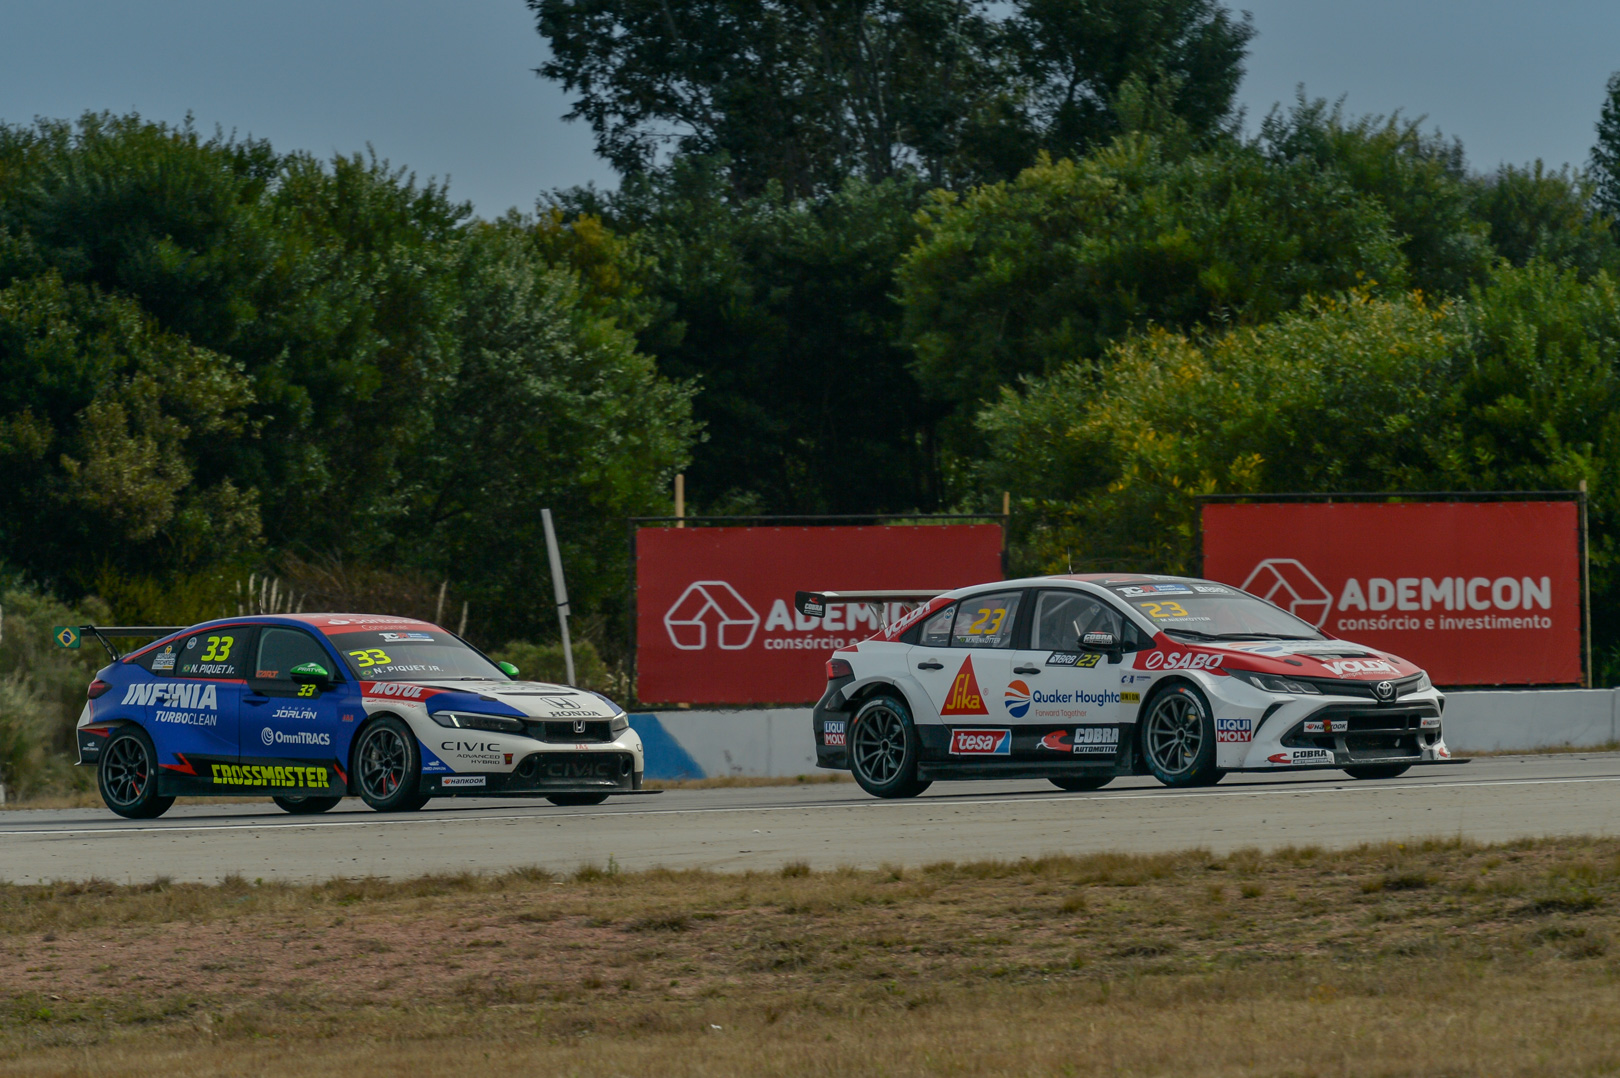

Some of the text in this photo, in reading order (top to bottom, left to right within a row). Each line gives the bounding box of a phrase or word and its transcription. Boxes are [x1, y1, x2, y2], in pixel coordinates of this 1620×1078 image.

[1116, 585, 1157, 595] TCR
[1338, 576, 1552, 612] ADEMICON
[1141, 601, 1188, 618] 23
[968, 608, 1006, 634] 23
[1337, 614, 1552, 632] consórcio e investimento
[201, 636, 234, 662] 33
[764, 634, 844, 650] consórcio
[348, 648, 392, 667] 33
[1076, 654, 1100, 666] 23
[190, 664, 198, 674] N.
[199, 665, 227, 674] PIQUET
[121, 684, 217, 710] INFINIA
[298, 684, 316, 696] 33
[369, 682, 424, 698] MOTUL
[946, 674, 980, 710] Sika
[1032, 689, 1072, 703] Quaker
[1121, 692, 1139, 700] UNION
[155, 710, 217, 726] TURBOCLEAN
[272, 710, 317, 719] JORLAN
[1061, 710, 1087, 718] Together
[826, 722, 844, 733] LIQUI
[1218, 720, 1250, 730] LIQUI
[275, 731, 330, 745] OmniTRACS
[826, 734, 846, 744] MOLY
[957, 732, 994, 750] tesa
[1074, 728, 1119, 743] COBRA
[1218, 732, 1250, 742] MOLY
[441, 742, 500, 752] CIVIC
[1293, 750, 1327, 758] COBRA
[211, 764, 330, 788] CROSSMASTER
[548, 763, 609, 776] CIVIC
